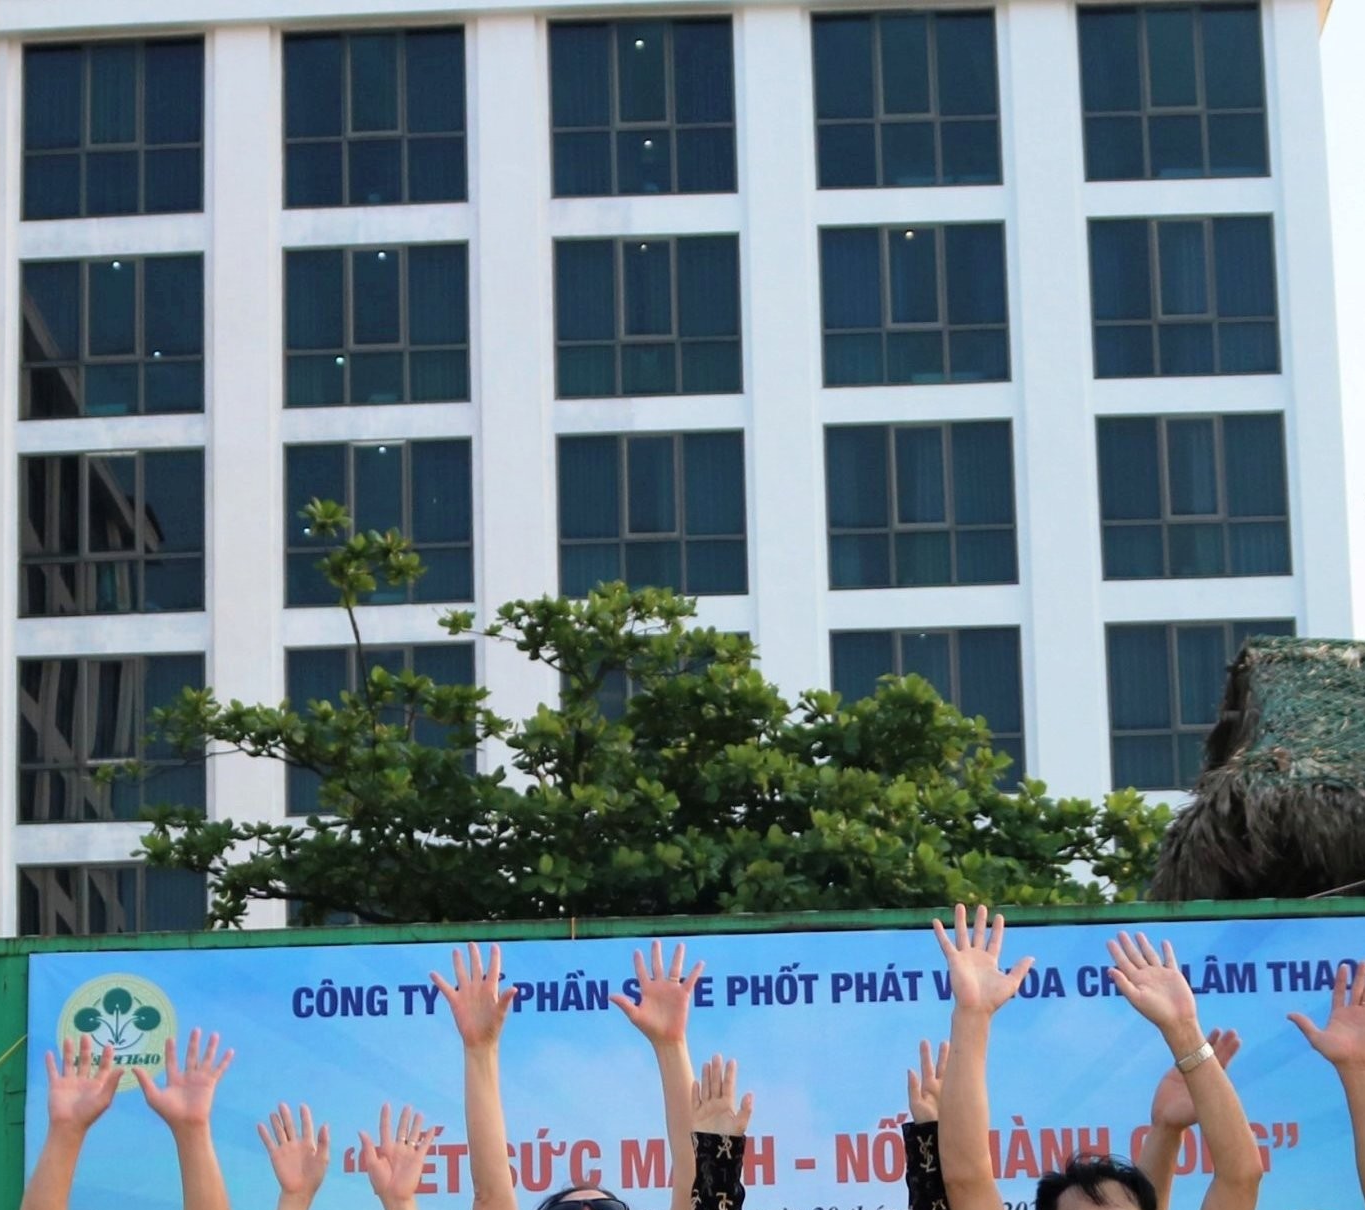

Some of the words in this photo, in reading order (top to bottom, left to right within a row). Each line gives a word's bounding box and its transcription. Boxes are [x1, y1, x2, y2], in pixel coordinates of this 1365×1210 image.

[292, 979, 388, 1018] CÔNG
[399, 984, 439, 1016] TY
[512, 969, 609, 1013] PHẦN
[622, 976, 714, 1009] SE
[727, 962, 819, 1007] PHỐT
[831, 962, 923, 1003] PHÁT
[1186, 955, 1257, 995] LÂM
[1267, 958, 1359, 993] THAO
[621, 1135, 776, 1189] MH
